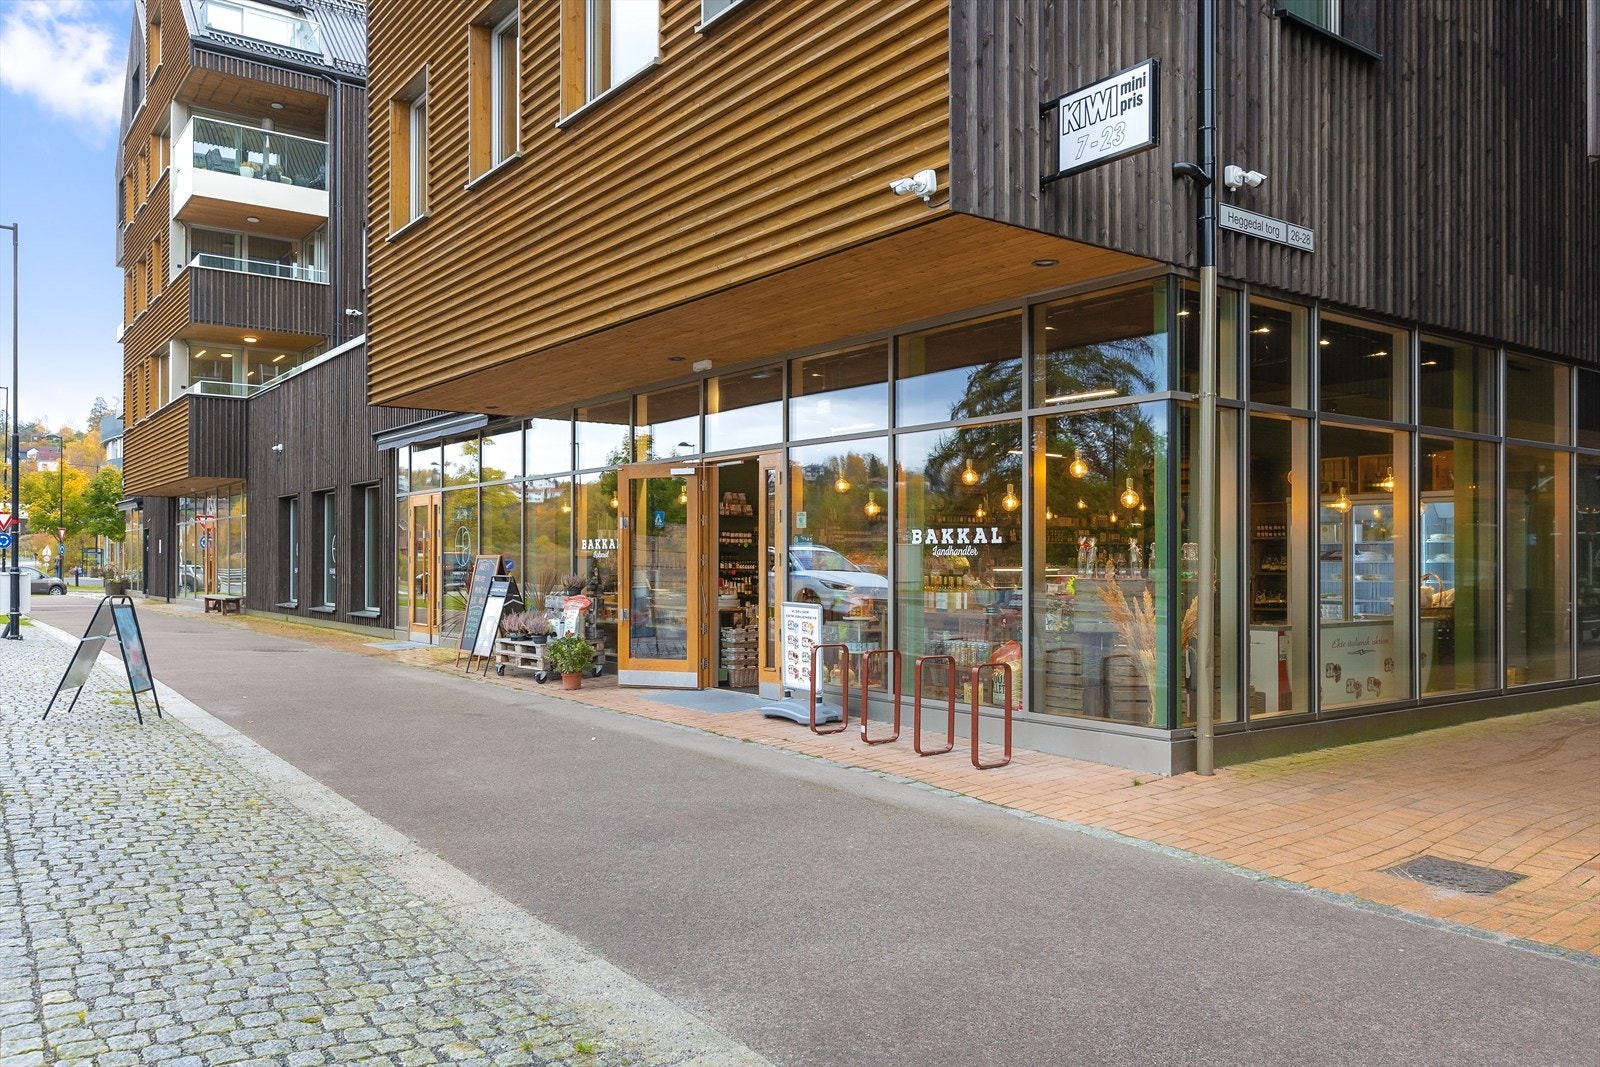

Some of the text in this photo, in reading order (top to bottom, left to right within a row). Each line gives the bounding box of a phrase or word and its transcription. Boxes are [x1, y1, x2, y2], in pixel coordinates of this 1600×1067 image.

[1062, 71, 1146, 136] KIWI mini
[1120, 93, 1143, 116] pris
[1099, 121, 1126, 152] 23
[1227, 211, 1311, 246] Heggedal torg 26-28
[911, 527, 1002, 544] BAKKAL
[932, 545, 979, 558] Landhandler
